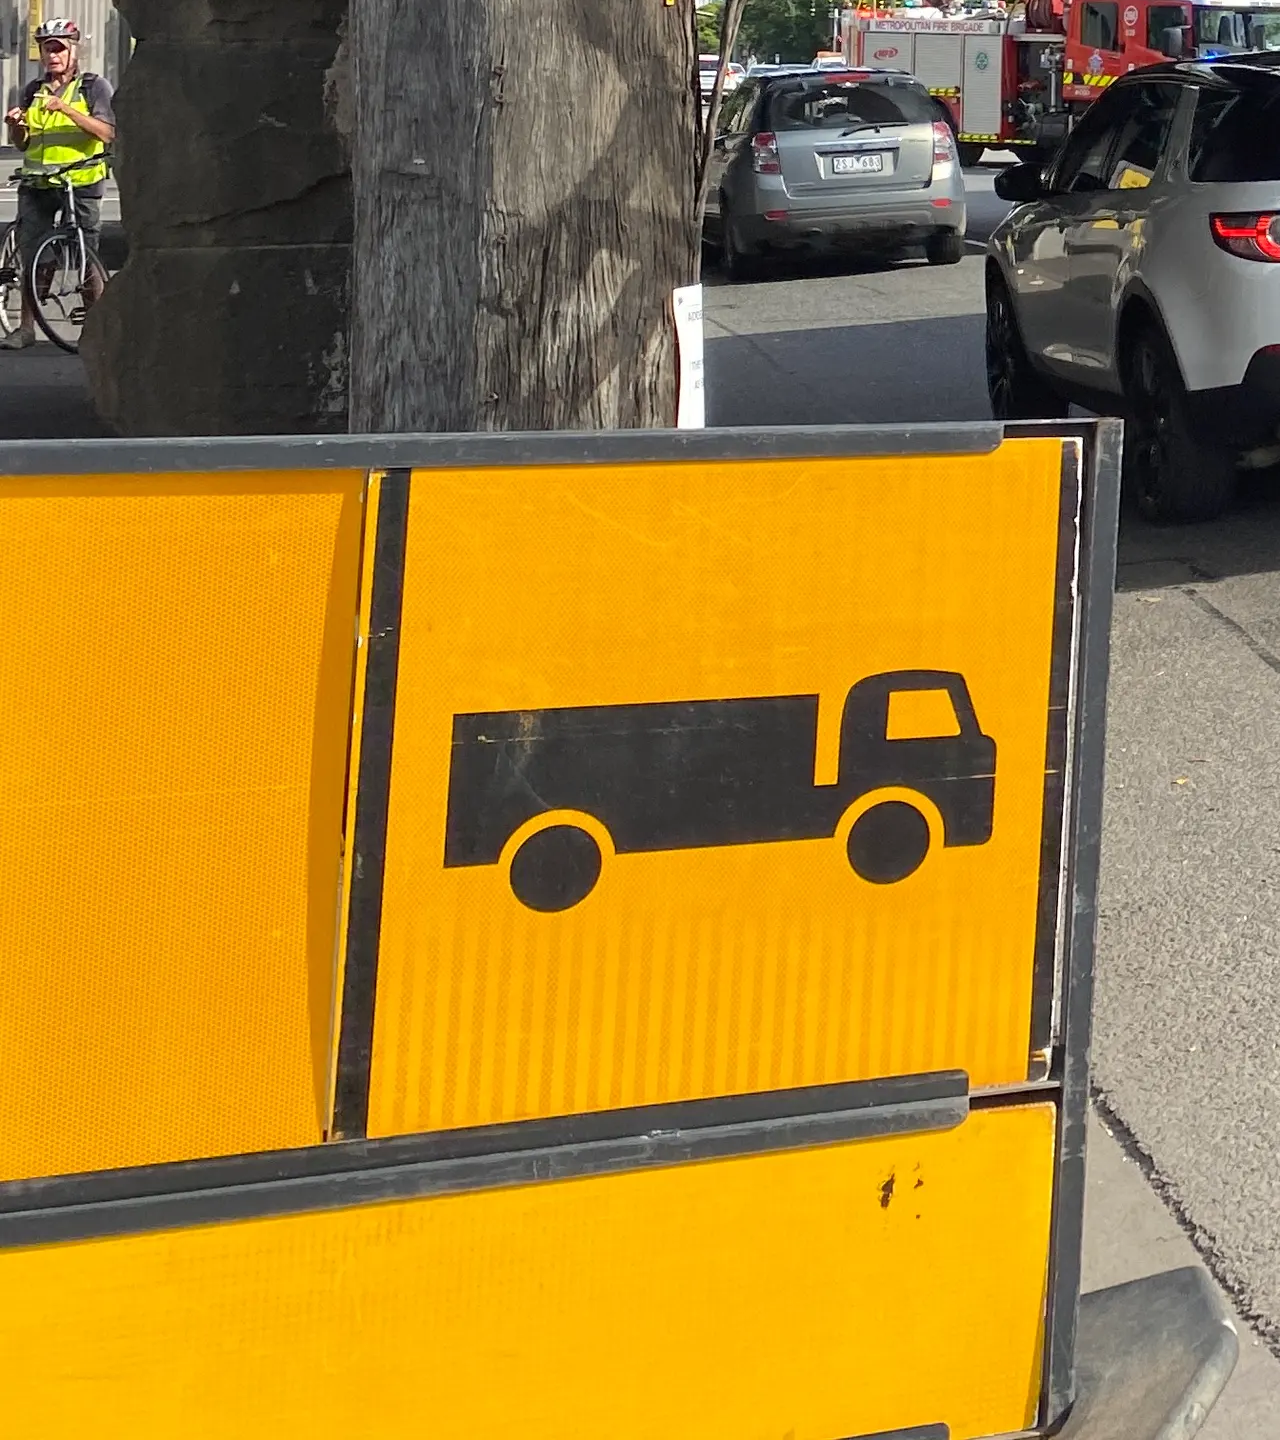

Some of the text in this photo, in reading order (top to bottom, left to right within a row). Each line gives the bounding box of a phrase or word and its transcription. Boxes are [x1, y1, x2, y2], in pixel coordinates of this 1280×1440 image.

[875, 20, 985, 32] METROPOLITAN FIRE BRIGADE
